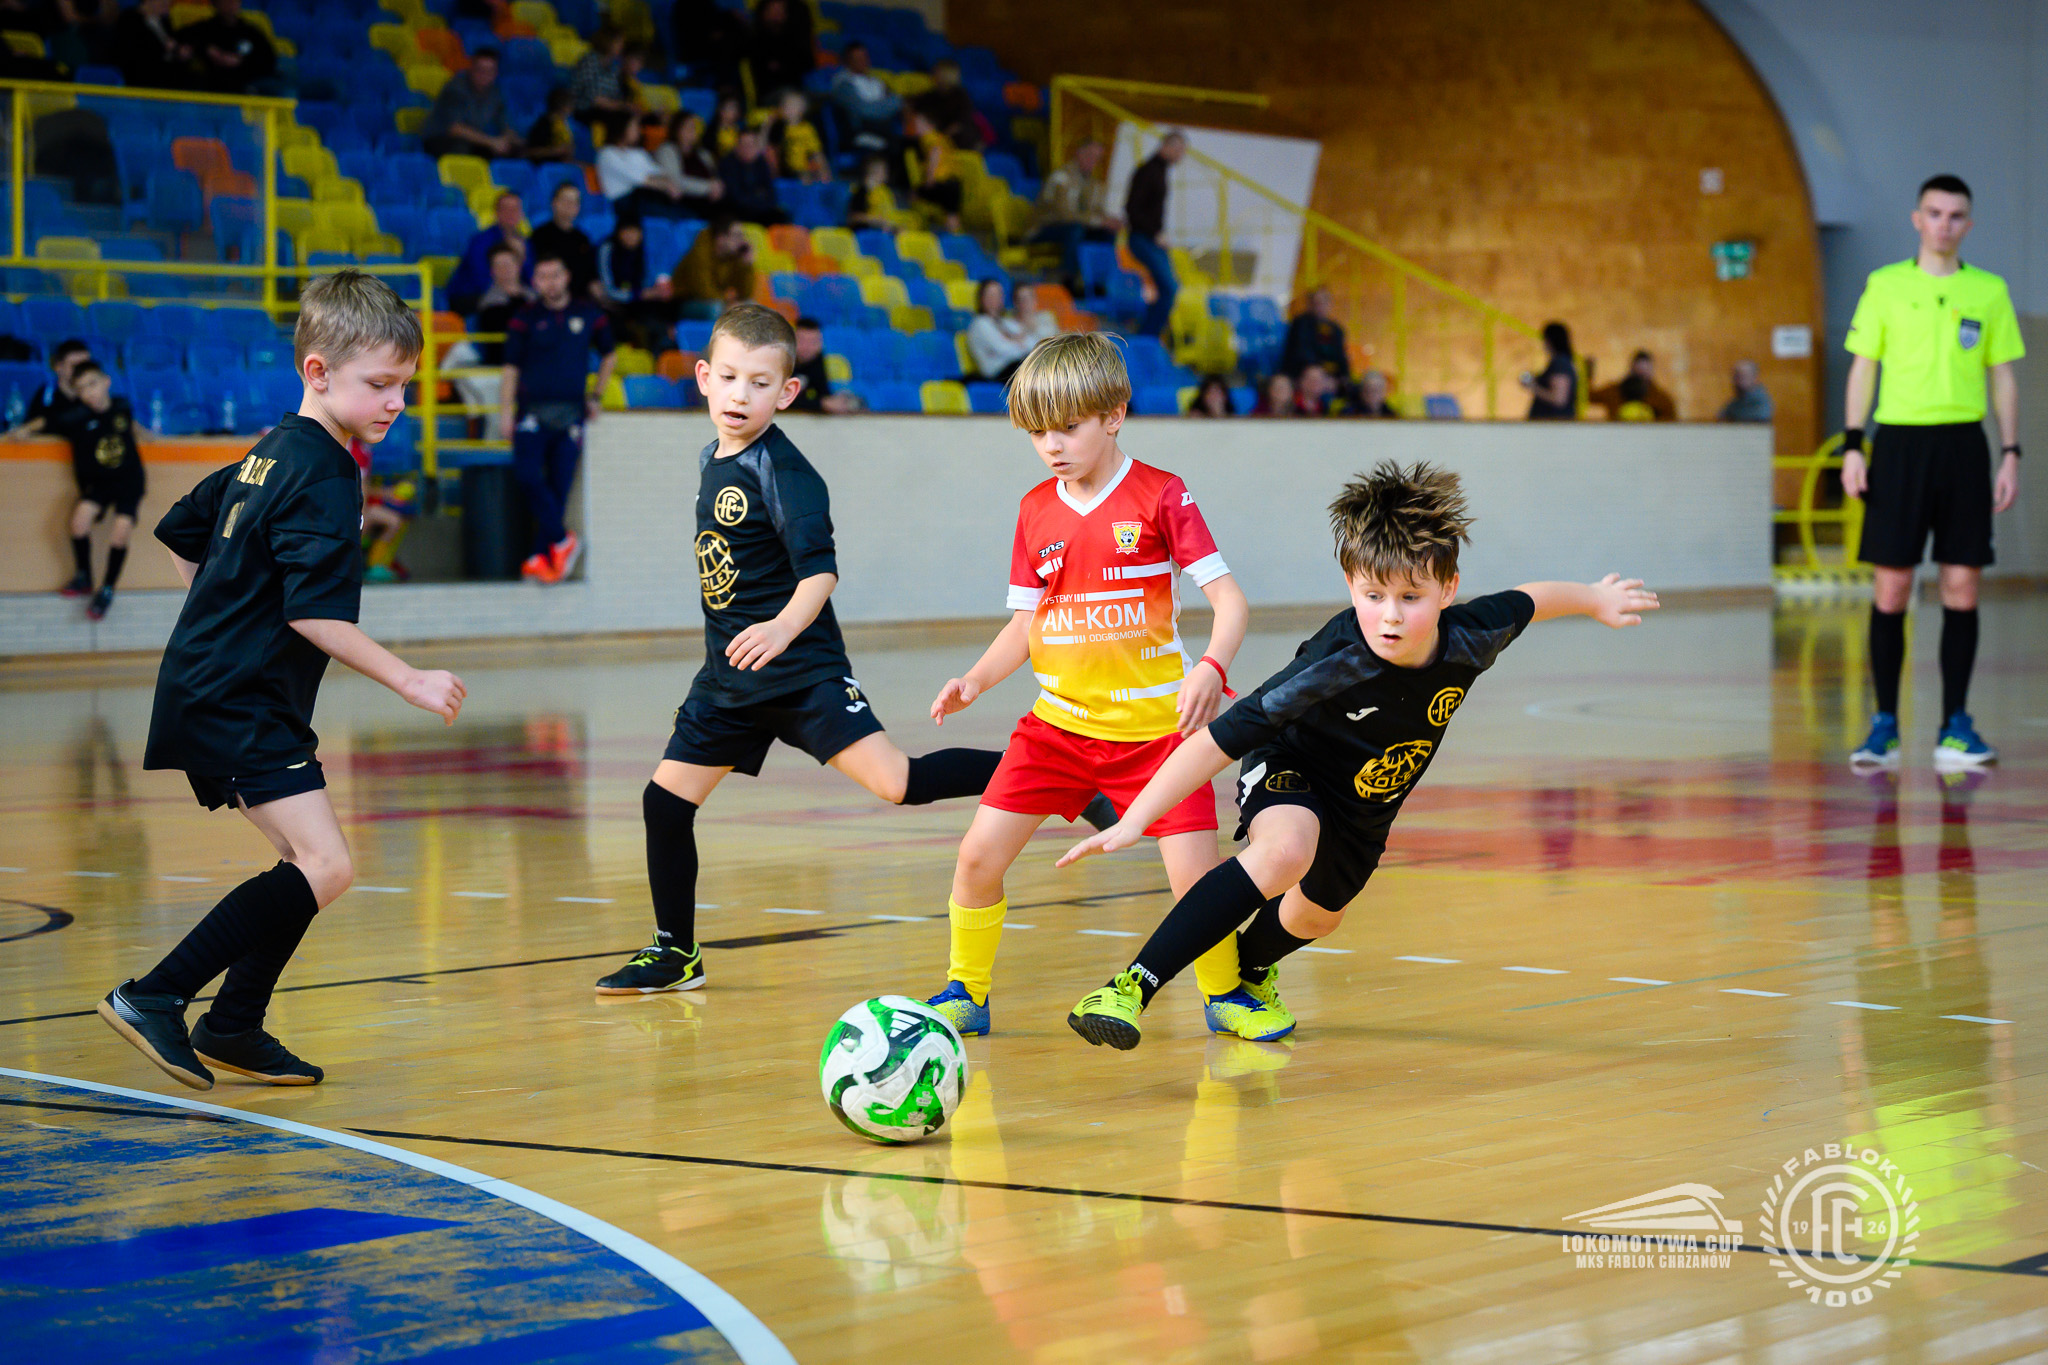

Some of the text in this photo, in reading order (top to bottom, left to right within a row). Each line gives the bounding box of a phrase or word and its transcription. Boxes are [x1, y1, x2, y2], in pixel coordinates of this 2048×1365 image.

[701, 564, 735, 591] OLEX
[1041, 602, 1146, 632] AN-KOM
[1089, 629, 1148, 643] ODGROMOWE
